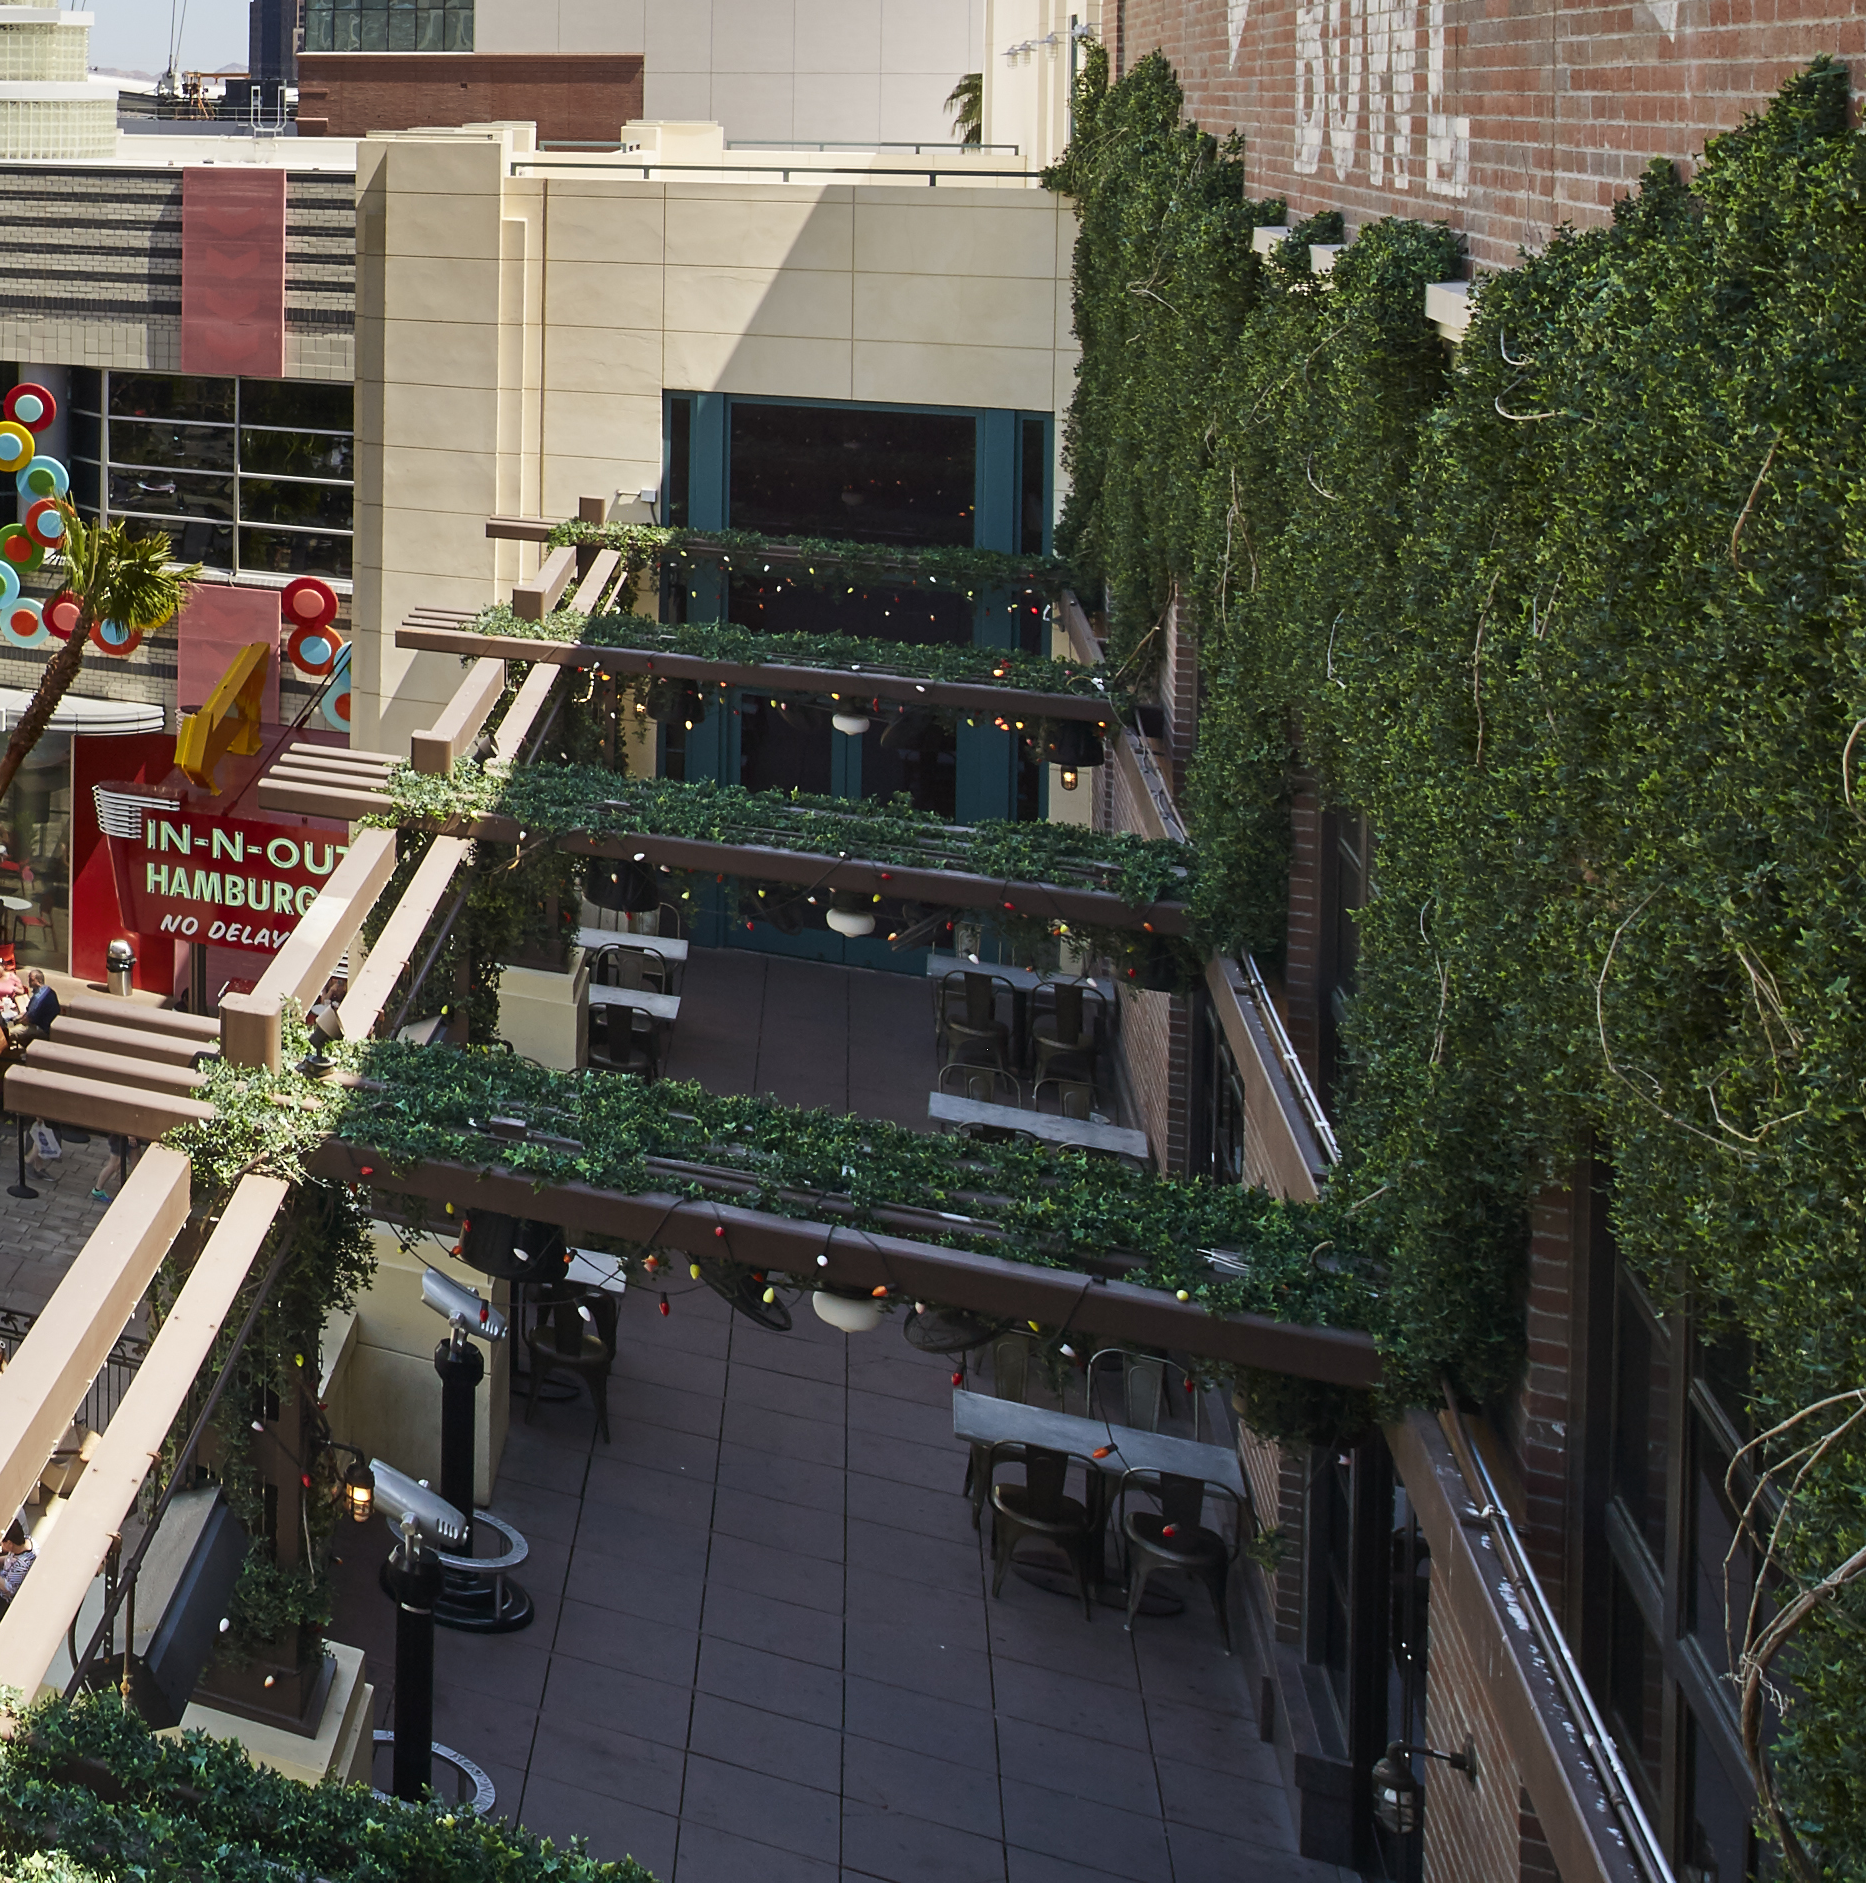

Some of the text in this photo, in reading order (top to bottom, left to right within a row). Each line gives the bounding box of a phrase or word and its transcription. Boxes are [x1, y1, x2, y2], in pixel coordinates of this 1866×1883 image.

[146, 862, 318, 917] HAMBURG
[159, 914, 292, 950] NO DELAY
